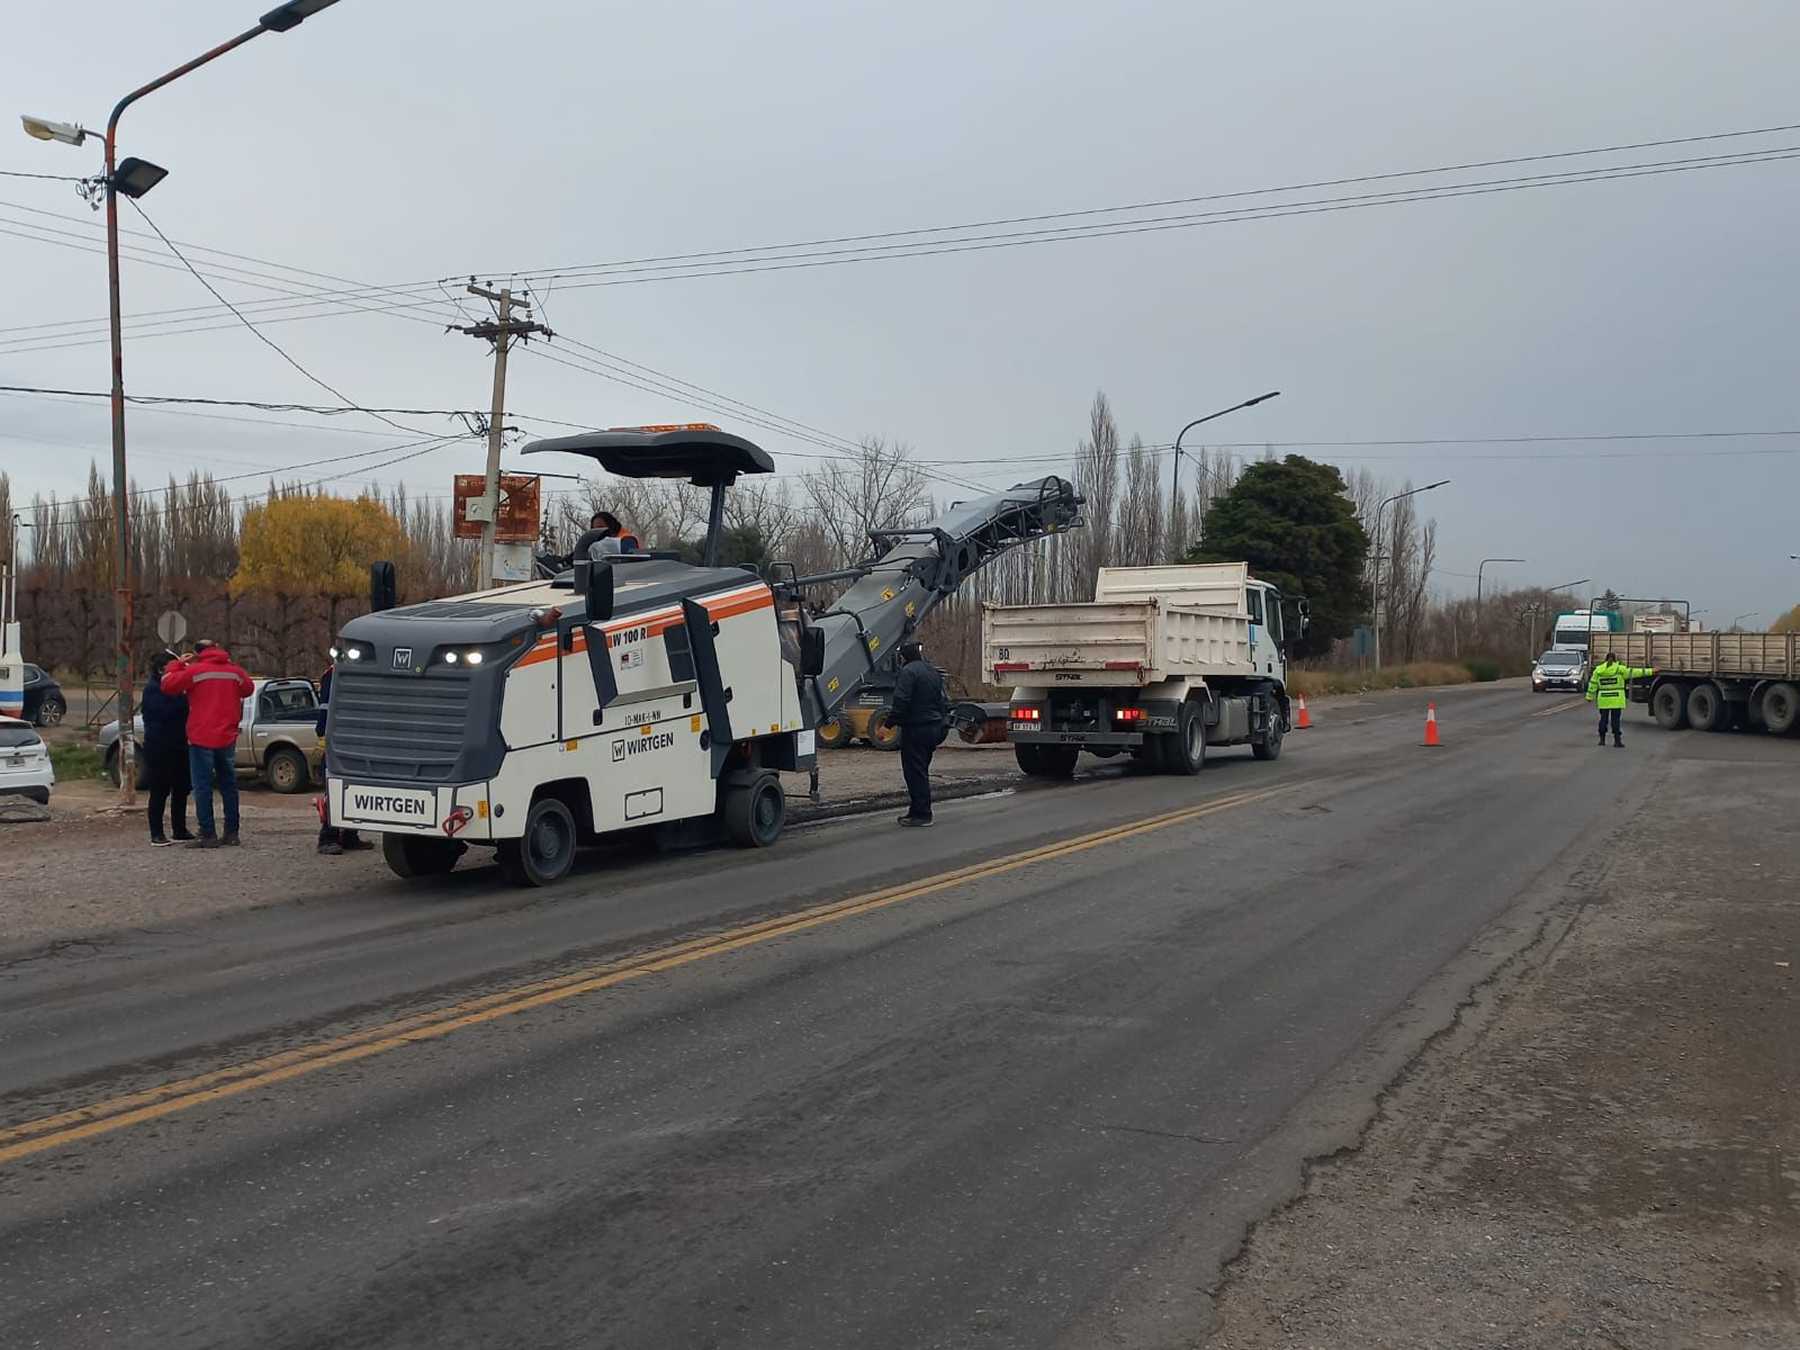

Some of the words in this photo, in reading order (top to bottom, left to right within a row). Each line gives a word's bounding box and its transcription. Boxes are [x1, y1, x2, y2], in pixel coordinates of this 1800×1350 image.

[613, 632, 622, 647] W
[623, 629, 639, 645] 100
[640, 627, 647, 640] R
[627, 732, 674, 755] WIRTGEN
[354, 794, 426, 815] WIRTGEN
